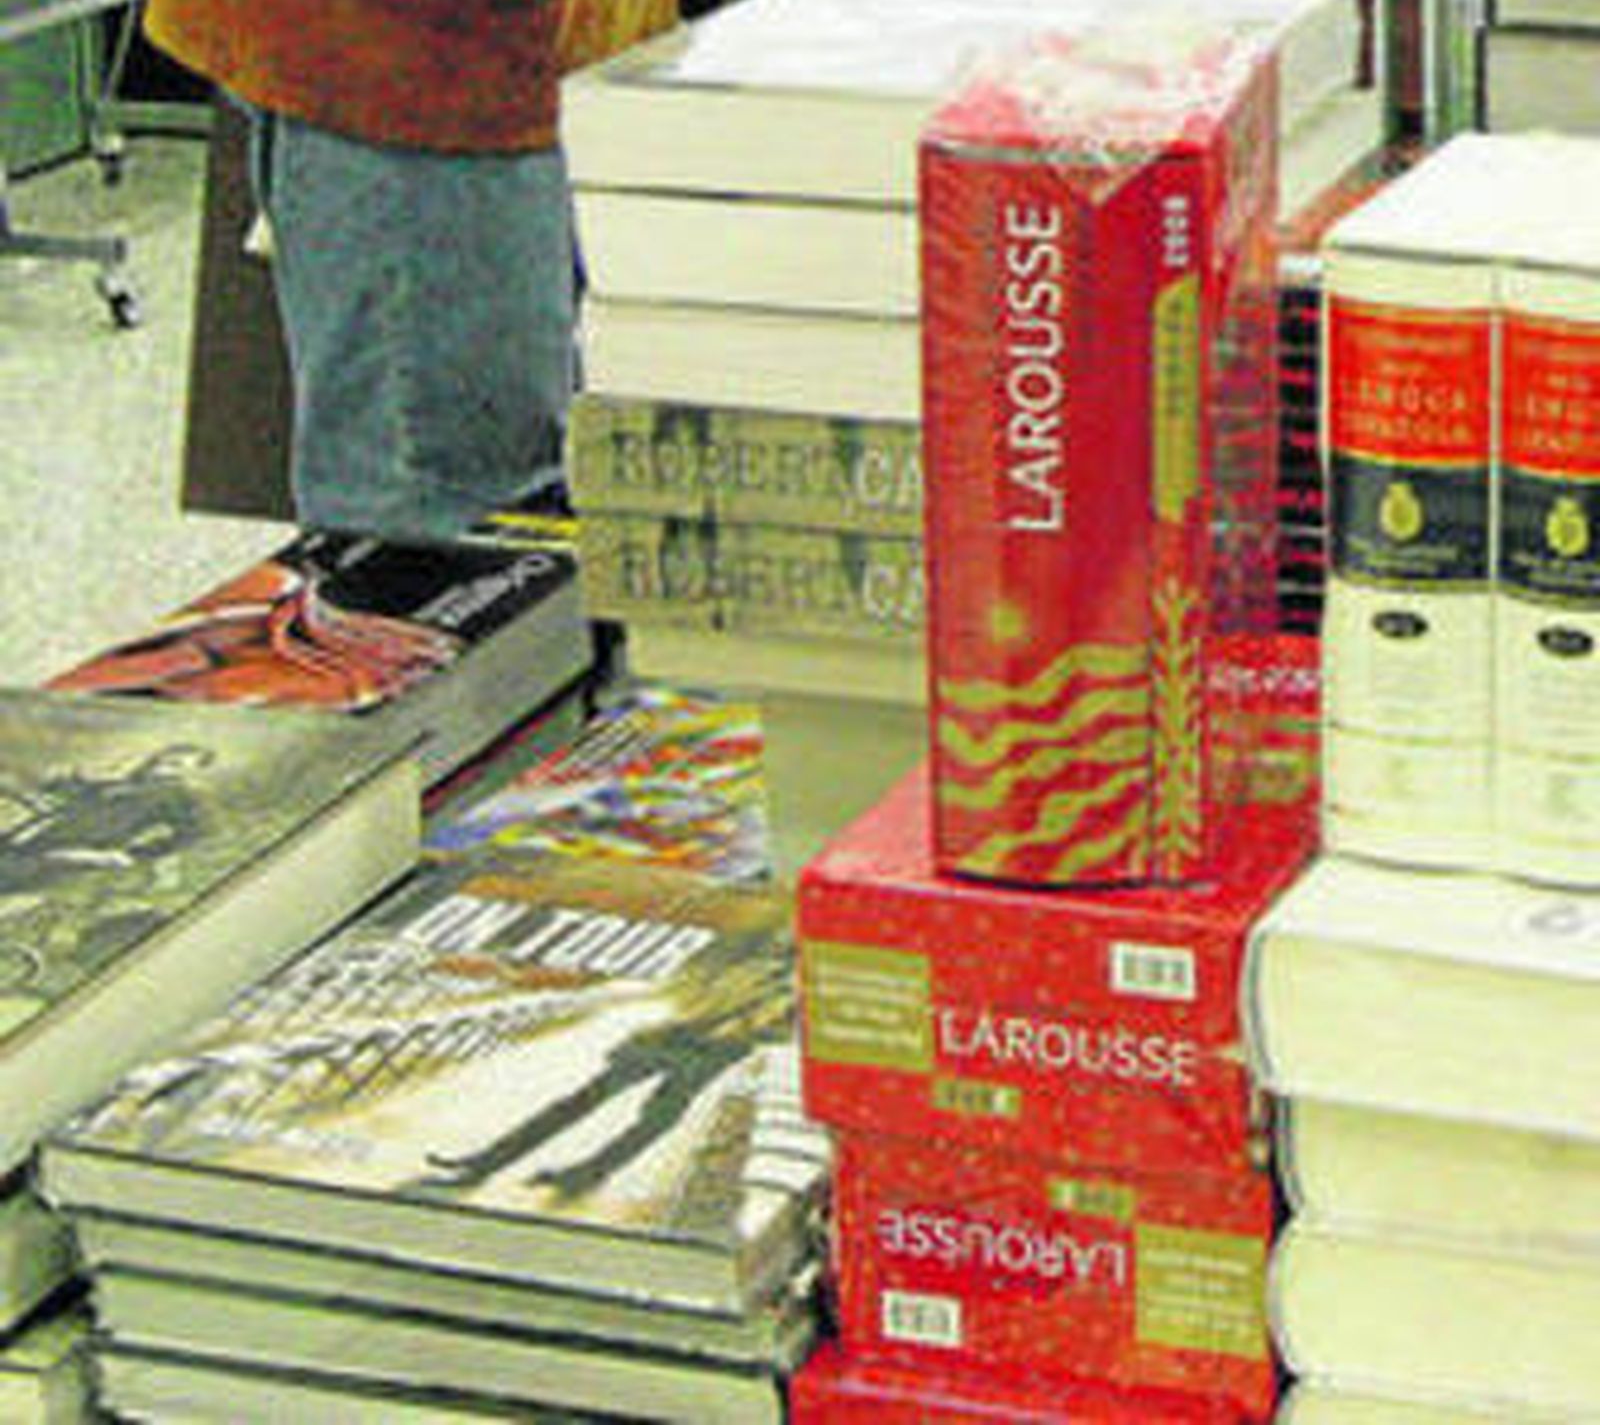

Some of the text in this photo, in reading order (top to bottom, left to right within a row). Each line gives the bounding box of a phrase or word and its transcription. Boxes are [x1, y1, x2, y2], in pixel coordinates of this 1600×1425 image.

[1006, 202, 1062, 532] LAROUSSE
[400, 894, 718, 978] ON TOUR
[938, 1007, 1200, 1087] LAROUSSE
[877, 1210, 1127, 1288] LAROUSSE
